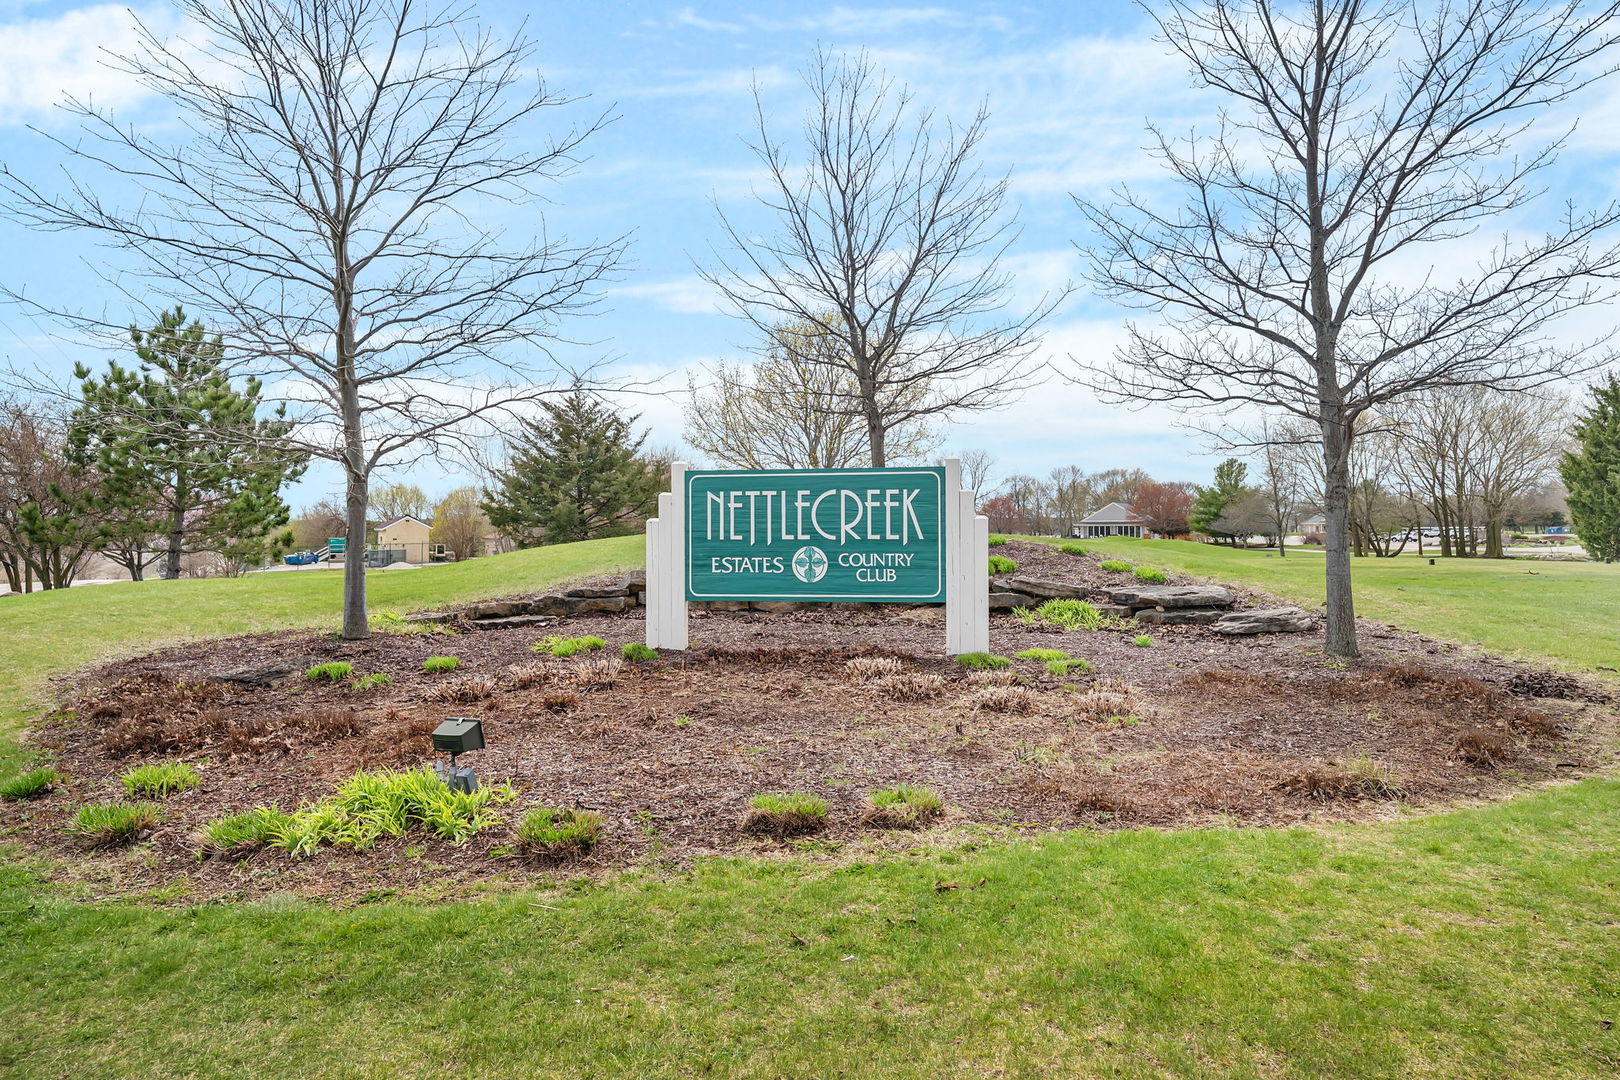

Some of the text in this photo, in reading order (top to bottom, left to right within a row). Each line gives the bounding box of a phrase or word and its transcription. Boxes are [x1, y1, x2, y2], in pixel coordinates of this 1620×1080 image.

[706, 488, 925, 546] NETTLECREEK
[711, 556, 785, 574] ESTATES
[838, 552, 915, 567] COUNTRY
[855, 568, 897, 582] CLUB
